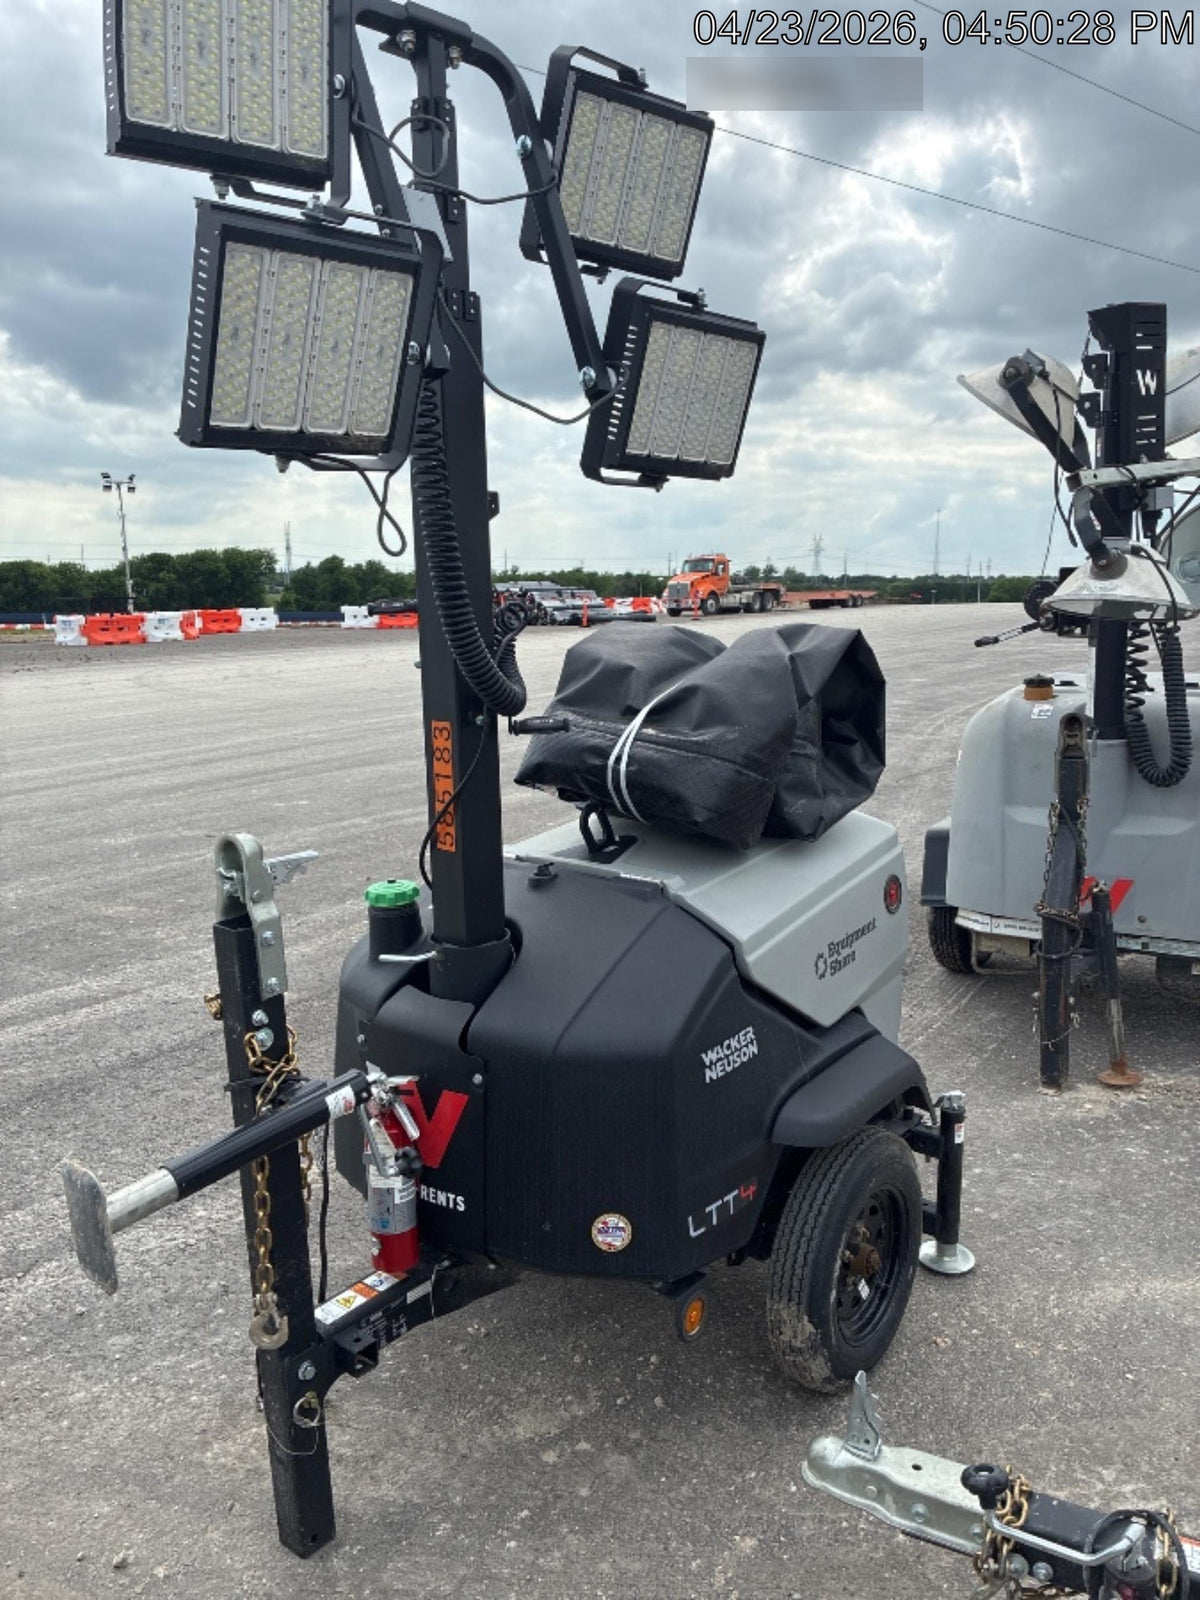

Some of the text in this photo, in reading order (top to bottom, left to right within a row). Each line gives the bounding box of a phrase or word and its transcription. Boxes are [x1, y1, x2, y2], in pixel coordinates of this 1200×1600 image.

[1136, 368, 1157, 396] W
[433, 726, 454, 848] 585183
[827, 917, 877, 959] Equipment
[829, 949, 856, 977] Share
[700, 1026, 757, 1066] WACKER
[704, 1040, 759, 1084] NEUSON
[420, 1185, 466, 1212] RENTS
[688, 1183, 757, 1238] LTT4
